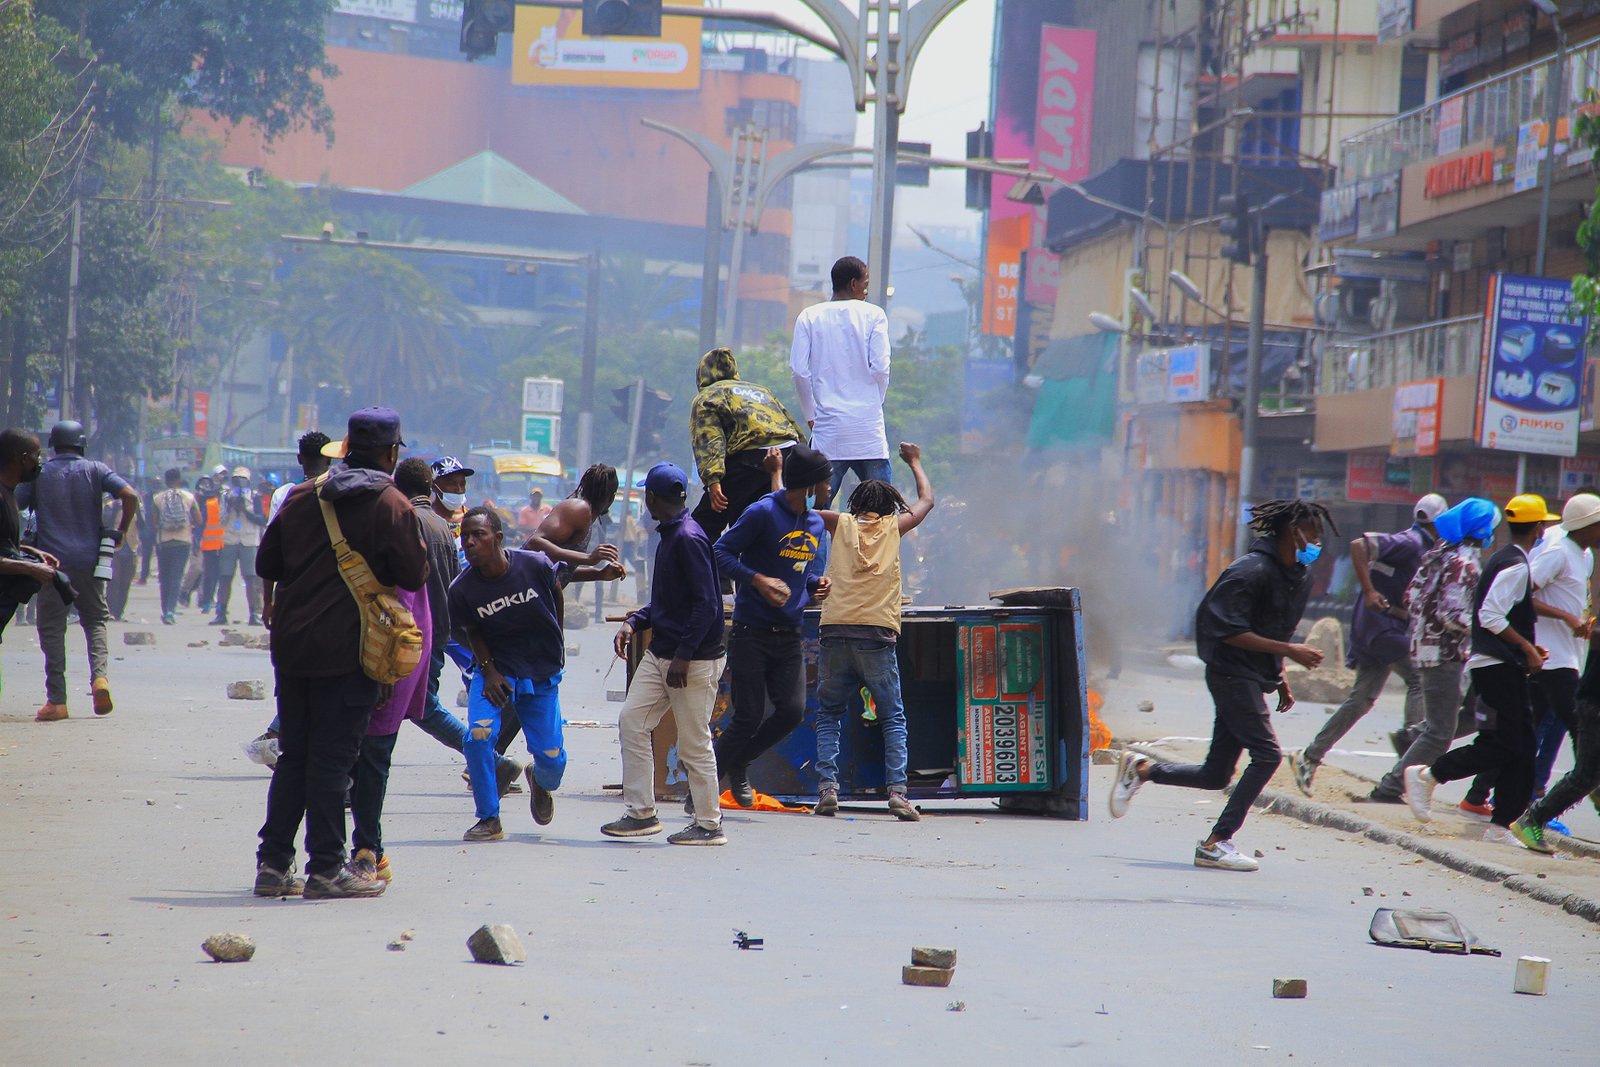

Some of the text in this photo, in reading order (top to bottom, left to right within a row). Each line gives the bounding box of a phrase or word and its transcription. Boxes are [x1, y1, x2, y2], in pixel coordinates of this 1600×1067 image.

[1525, 285, 1542, 300] ONE
[1542, 288, 1565, 302] STOP
[477, 588, 539, 618] NOKIA
[975, 632, 984, 694] LINES AVAILABLE
[995, 706, 1016, 782] 2039603
[1019, 712, 1027, 752] AGENT
